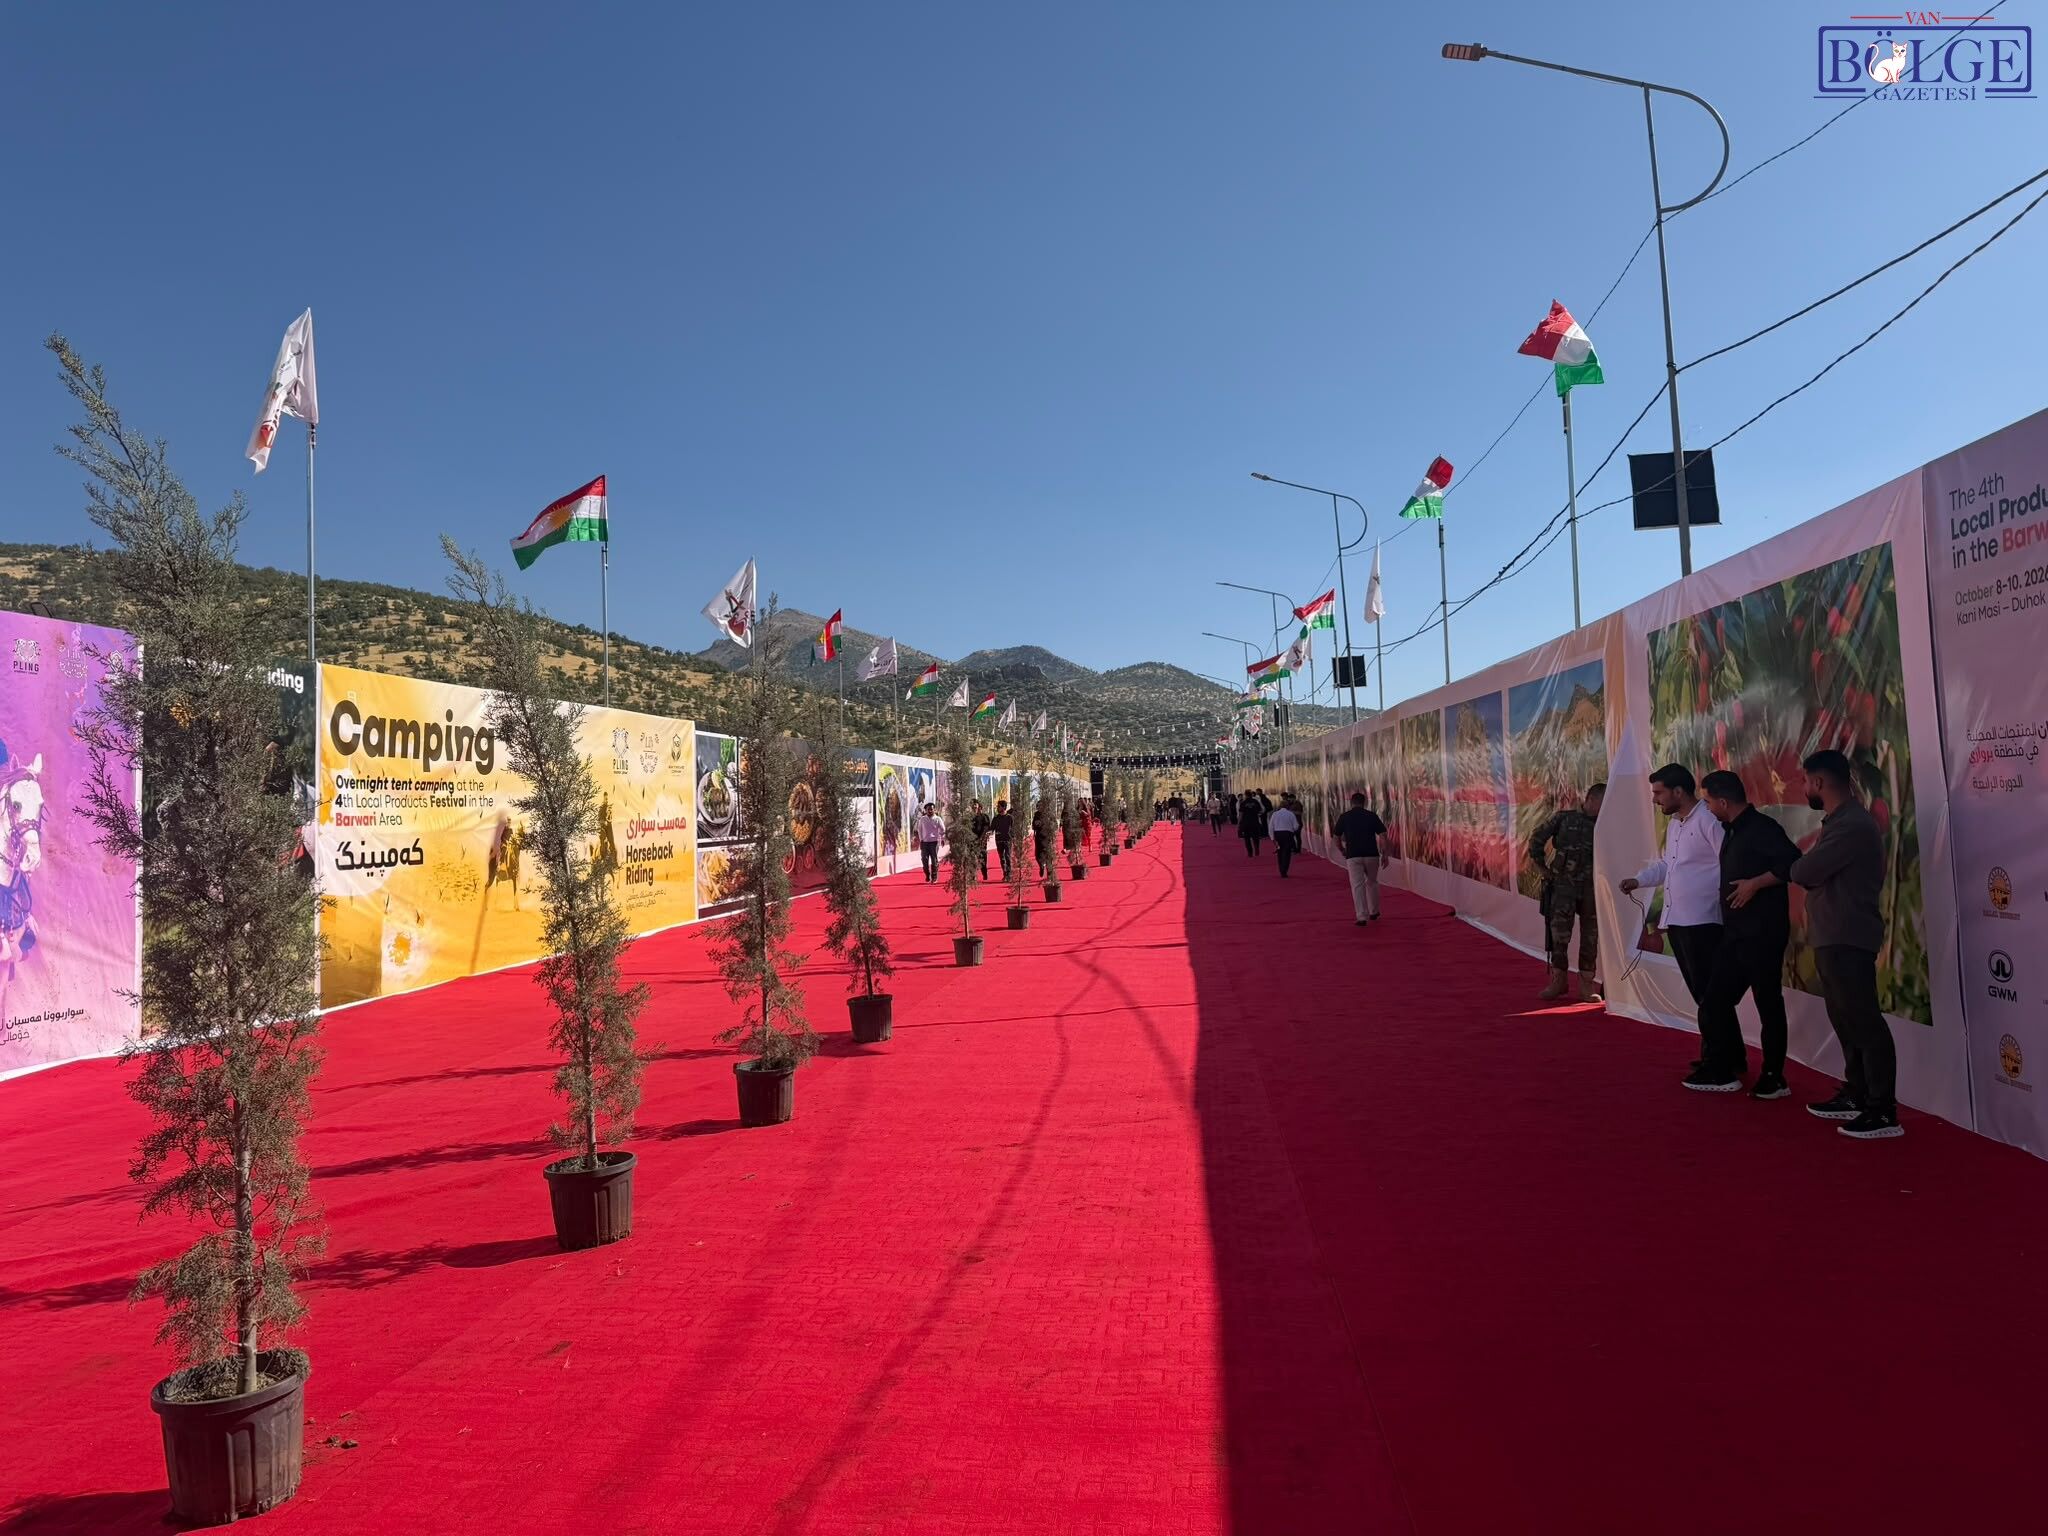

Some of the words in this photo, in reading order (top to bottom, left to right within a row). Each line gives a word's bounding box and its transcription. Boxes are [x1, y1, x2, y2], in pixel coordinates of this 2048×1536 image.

[1949, 488, 1976, 512] The
[1978, 472, 2004, 499] 4th
[1951, 502, 1995, 541] Local
[1952, 545, 1966, 569] in
[1970, 537, 1998, 562] the
[1955, 585, 1994, 606] October
[1957, 607, 1977, 627] Kani
[1978, 601, 2001, 620] Masi
[2011, 590, 2046, 612] Duhok
[13, 660, 40, 672] PLING
[330, 700, 495, 776] Camping
[335, 774, 389, 793] Overnight
[391, 778, 412, 791] tent
[414, 778, 455, 794] camping
[456, 780, 468, 791] at
[469, 779, 485, 792] the
[335, 793, 354, 808] 4th
[356, 794, 382, 808] Local
[385, 794, 428, 809] Products
[430, 793, 467, 808] Festival
[468, 795, 477, 807] in
[479, 795, 494, 808] the
[335, 812, 377, 827] Barwari
[379, 813, 403, 826] Area
[626, 841, 674, 864] Horseback
[626, 863, 654, 887] Riding
[1988, 985, 2018, 1003] GWM
